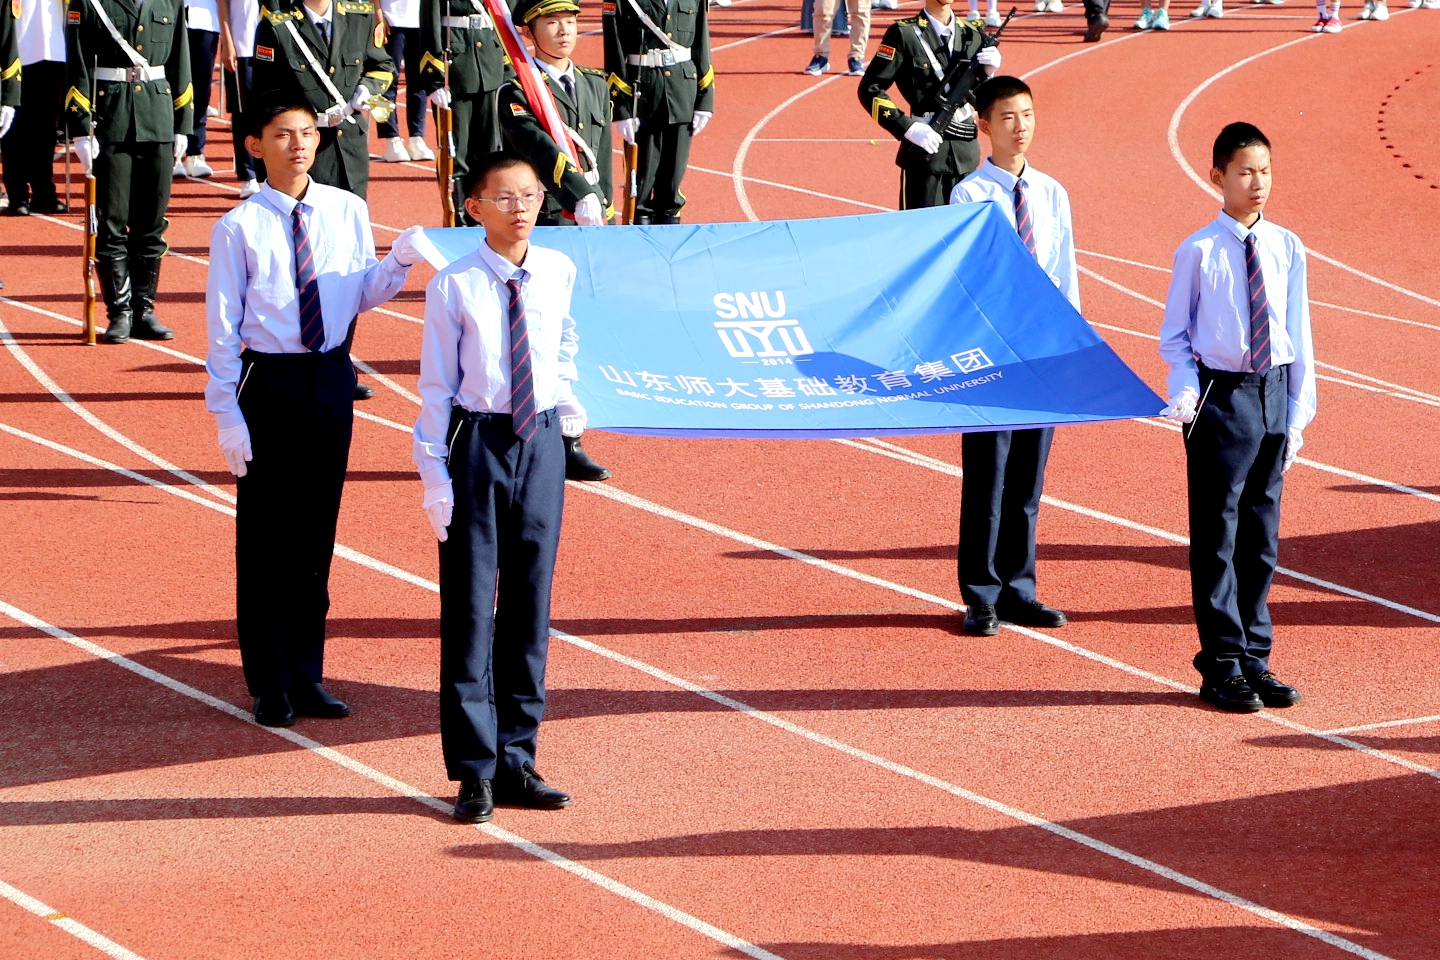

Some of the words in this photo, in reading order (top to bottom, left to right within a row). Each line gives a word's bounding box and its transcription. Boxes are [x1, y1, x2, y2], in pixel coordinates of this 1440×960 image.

[713, 290, 786, 319] SNU
[599, 347, 995, 399] 山东师大基础教育集团
[761, 357, 793, 367] 2014
[615, 388, 652, 401] BASIC
[653, 395, 728, 409] EDUCATION
[730, 402, 774, 411] GROUP
[777, 401, 795, 411] OF
[797, 398, 875, 410] SHANDONG
[877, 390, 933, 404] NORMAL
[933, 370, 1005, 395] UNIVERSITY
